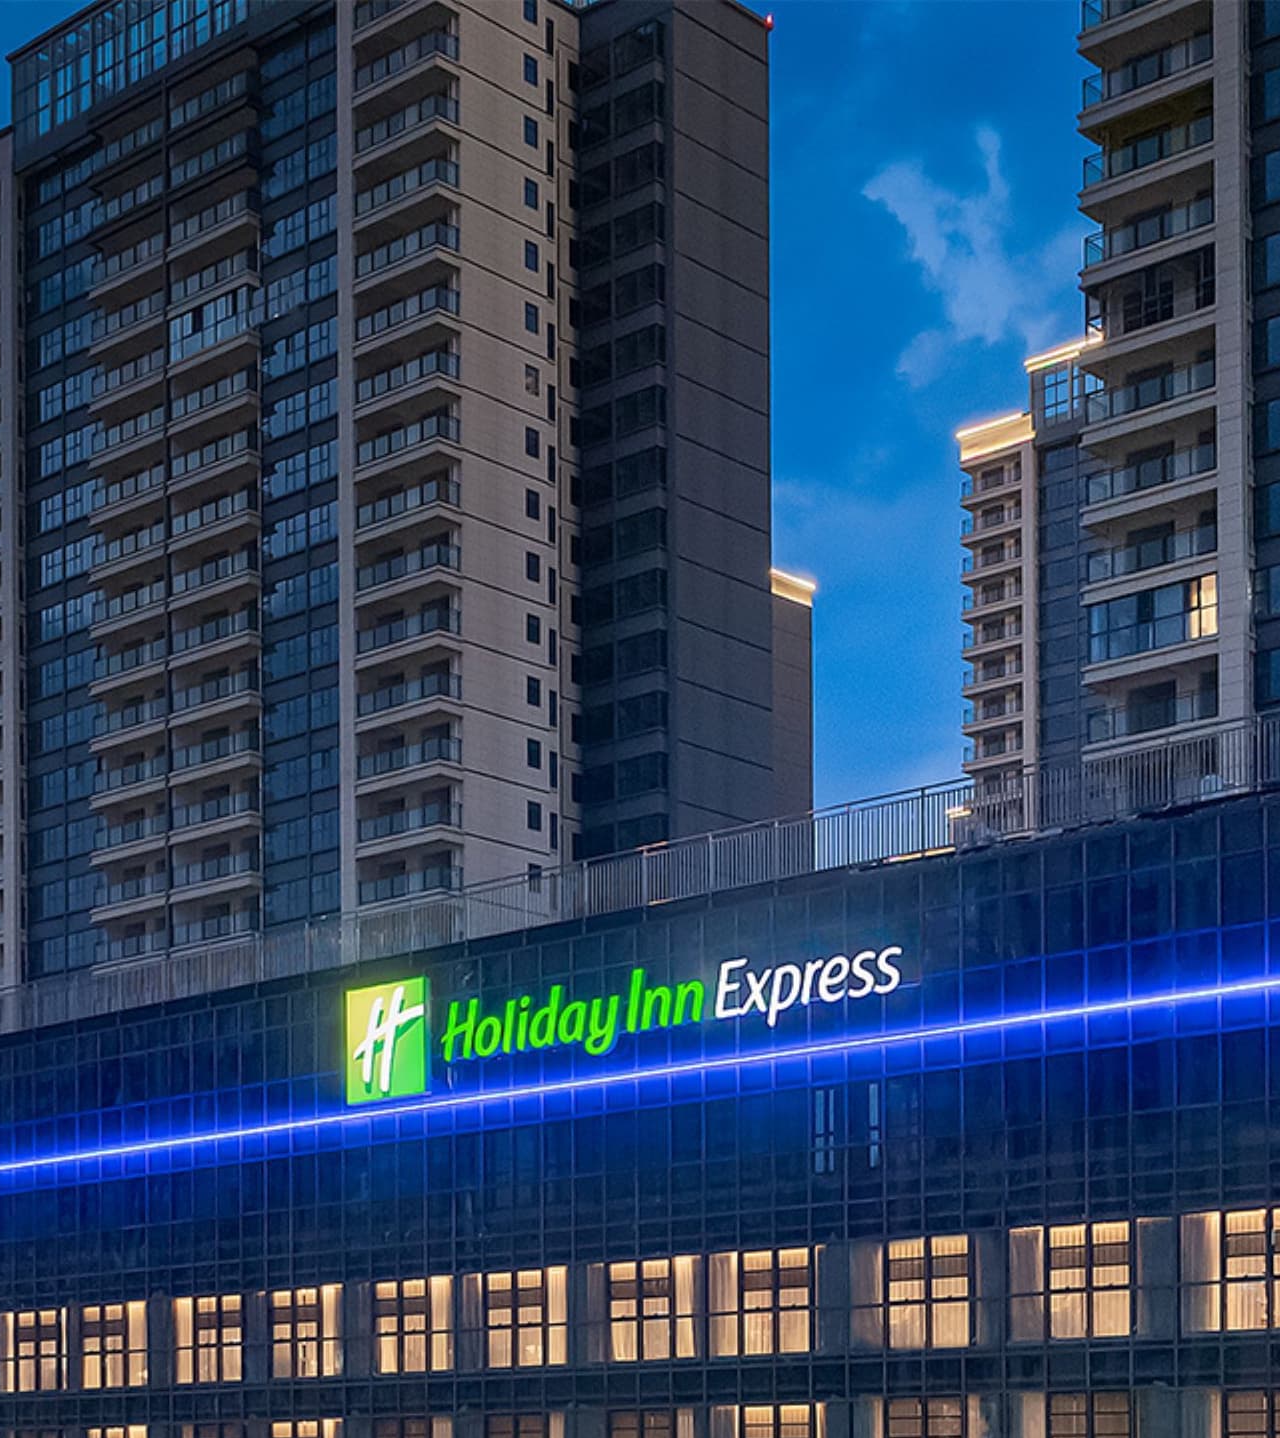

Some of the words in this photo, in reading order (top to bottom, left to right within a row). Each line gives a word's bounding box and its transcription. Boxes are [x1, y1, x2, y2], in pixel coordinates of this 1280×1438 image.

[441, 984, 619, 1062] Holiday
[626, 967, 704, 1034] Inn
[714, 946, 903, 1027] Express
